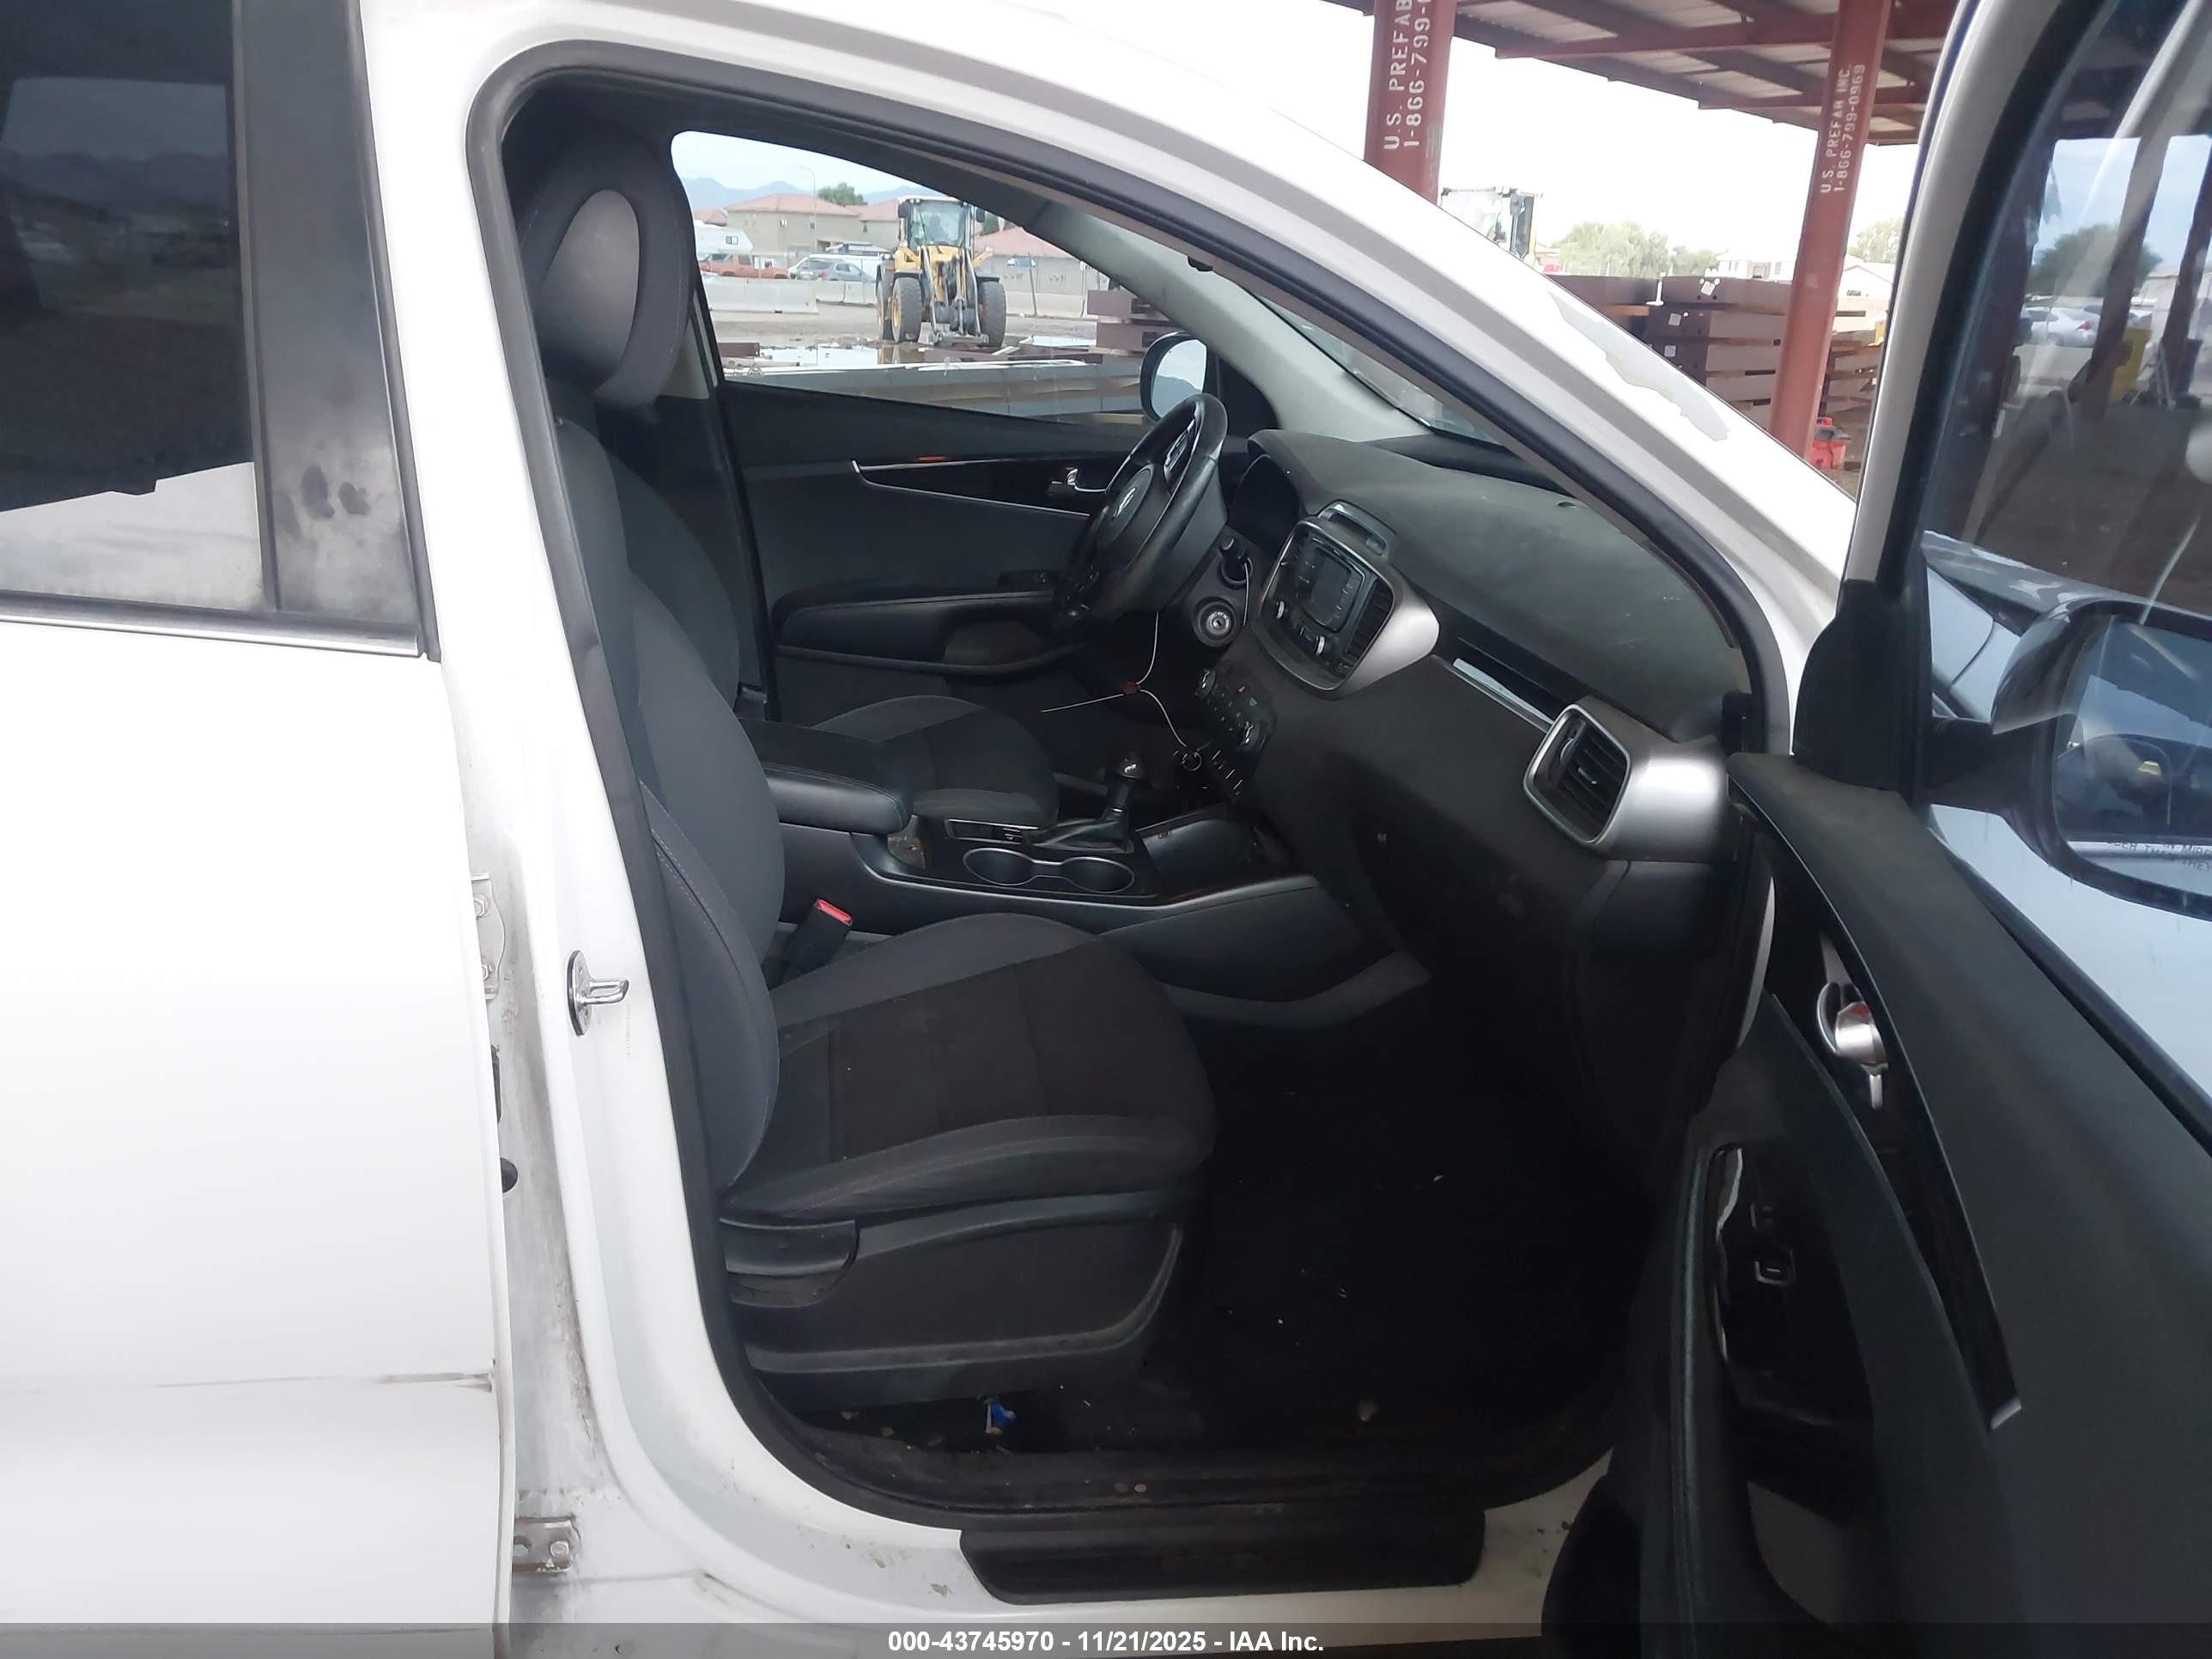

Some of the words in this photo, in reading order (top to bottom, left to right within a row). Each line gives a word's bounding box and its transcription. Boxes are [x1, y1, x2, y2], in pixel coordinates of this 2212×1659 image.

[1389, 0, 1413, 91] PREFAB
[1383, 105, 1403, 150] U.S.
[1826, 100, 1844, 157] PREFAB
[1820, 165, 1835, 193] U.S.
